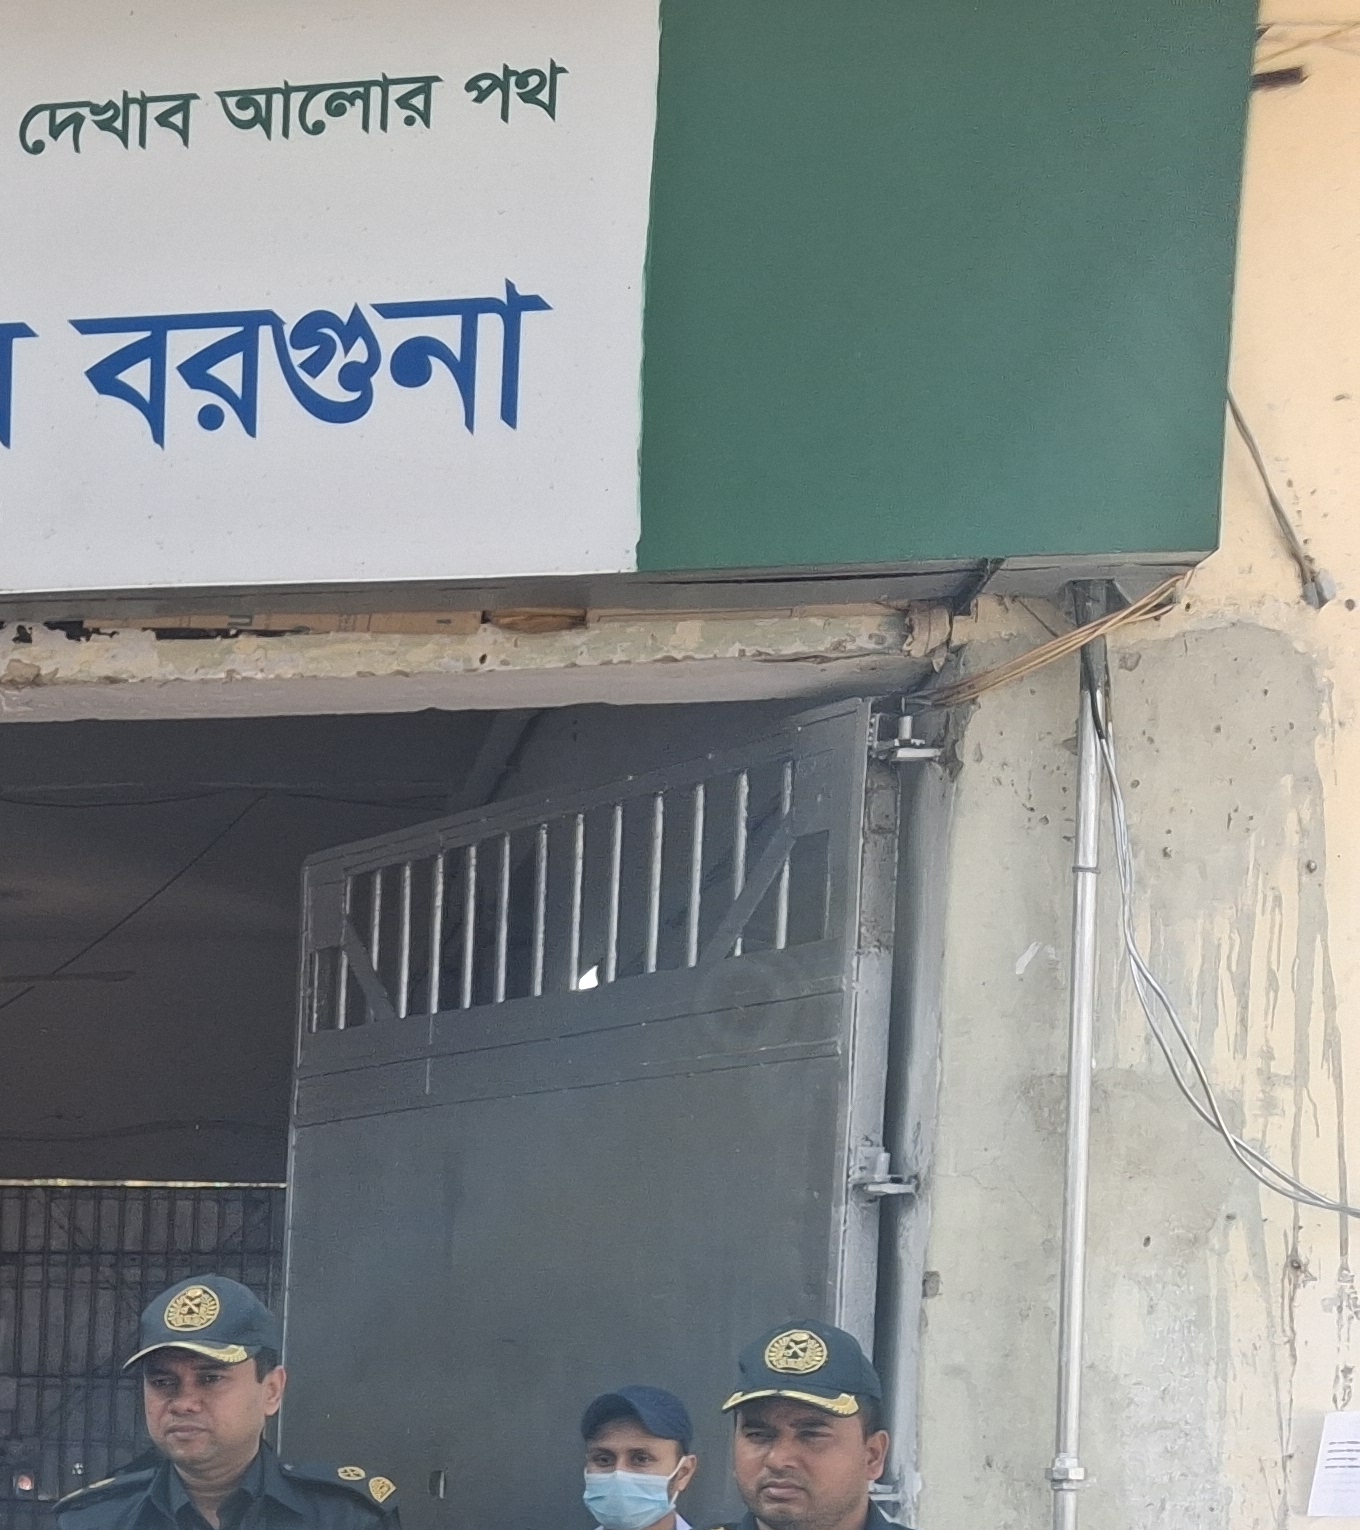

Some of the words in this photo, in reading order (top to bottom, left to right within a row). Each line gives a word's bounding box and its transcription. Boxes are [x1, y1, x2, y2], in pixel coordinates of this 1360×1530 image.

[18, 90, 201, 156] দেখাব
[215, 73, 443, 141] আলোর
[463, 57, 570, 124] পথ
[67, 277, 554, 450] বরগুনা
